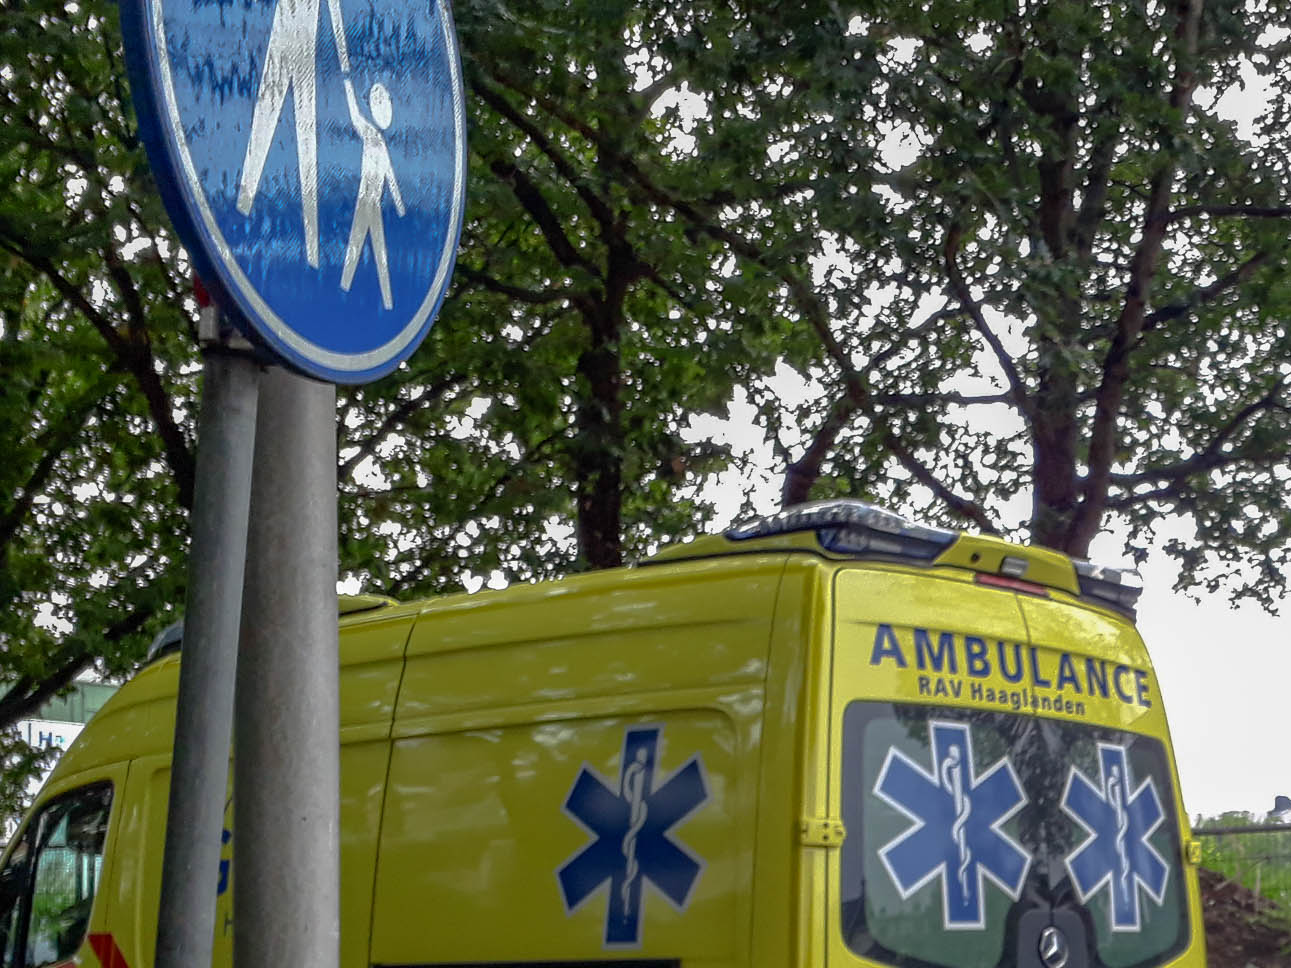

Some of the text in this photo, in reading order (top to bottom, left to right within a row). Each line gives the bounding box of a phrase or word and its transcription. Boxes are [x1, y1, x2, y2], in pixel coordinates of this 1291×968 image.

[869, 623, 1152, 708] AMBULANCE
[918, 675, 1086, 716] RAV Haaglanden
